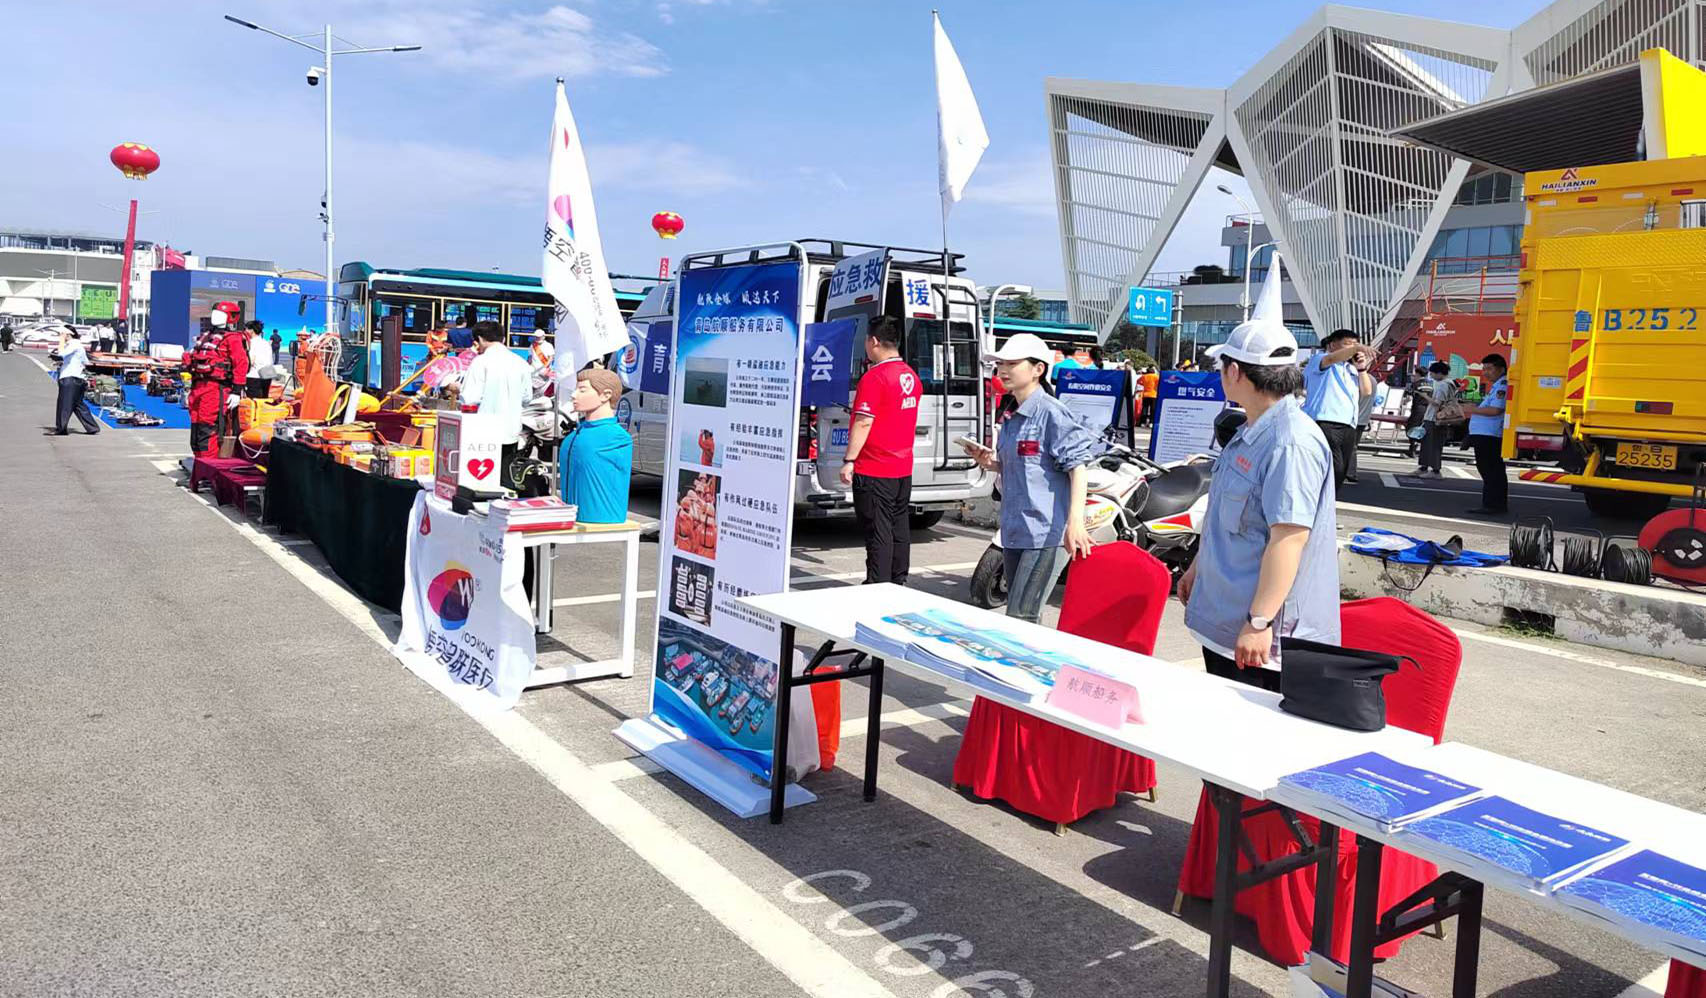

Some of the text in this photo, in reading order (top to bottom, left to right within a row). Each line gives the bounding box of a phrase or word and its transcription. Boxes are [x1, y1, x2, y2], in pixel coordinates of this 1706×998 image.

[1541, 179, 1597, 190] HAILIANXIN
[829, 257, 930, 307] 应急救 援
[653, 343, 667, 374] 青
[811, 345, 834, 382] 会
[1177, 386, 1215, 398] 燃气安全
[901, 396, 917, 410] AED
[467, 443, 497, 452] AED
[1618, 452, 1674, 468] 25235
[724, 492, 778, 515] 有作风过硬应急队伍
